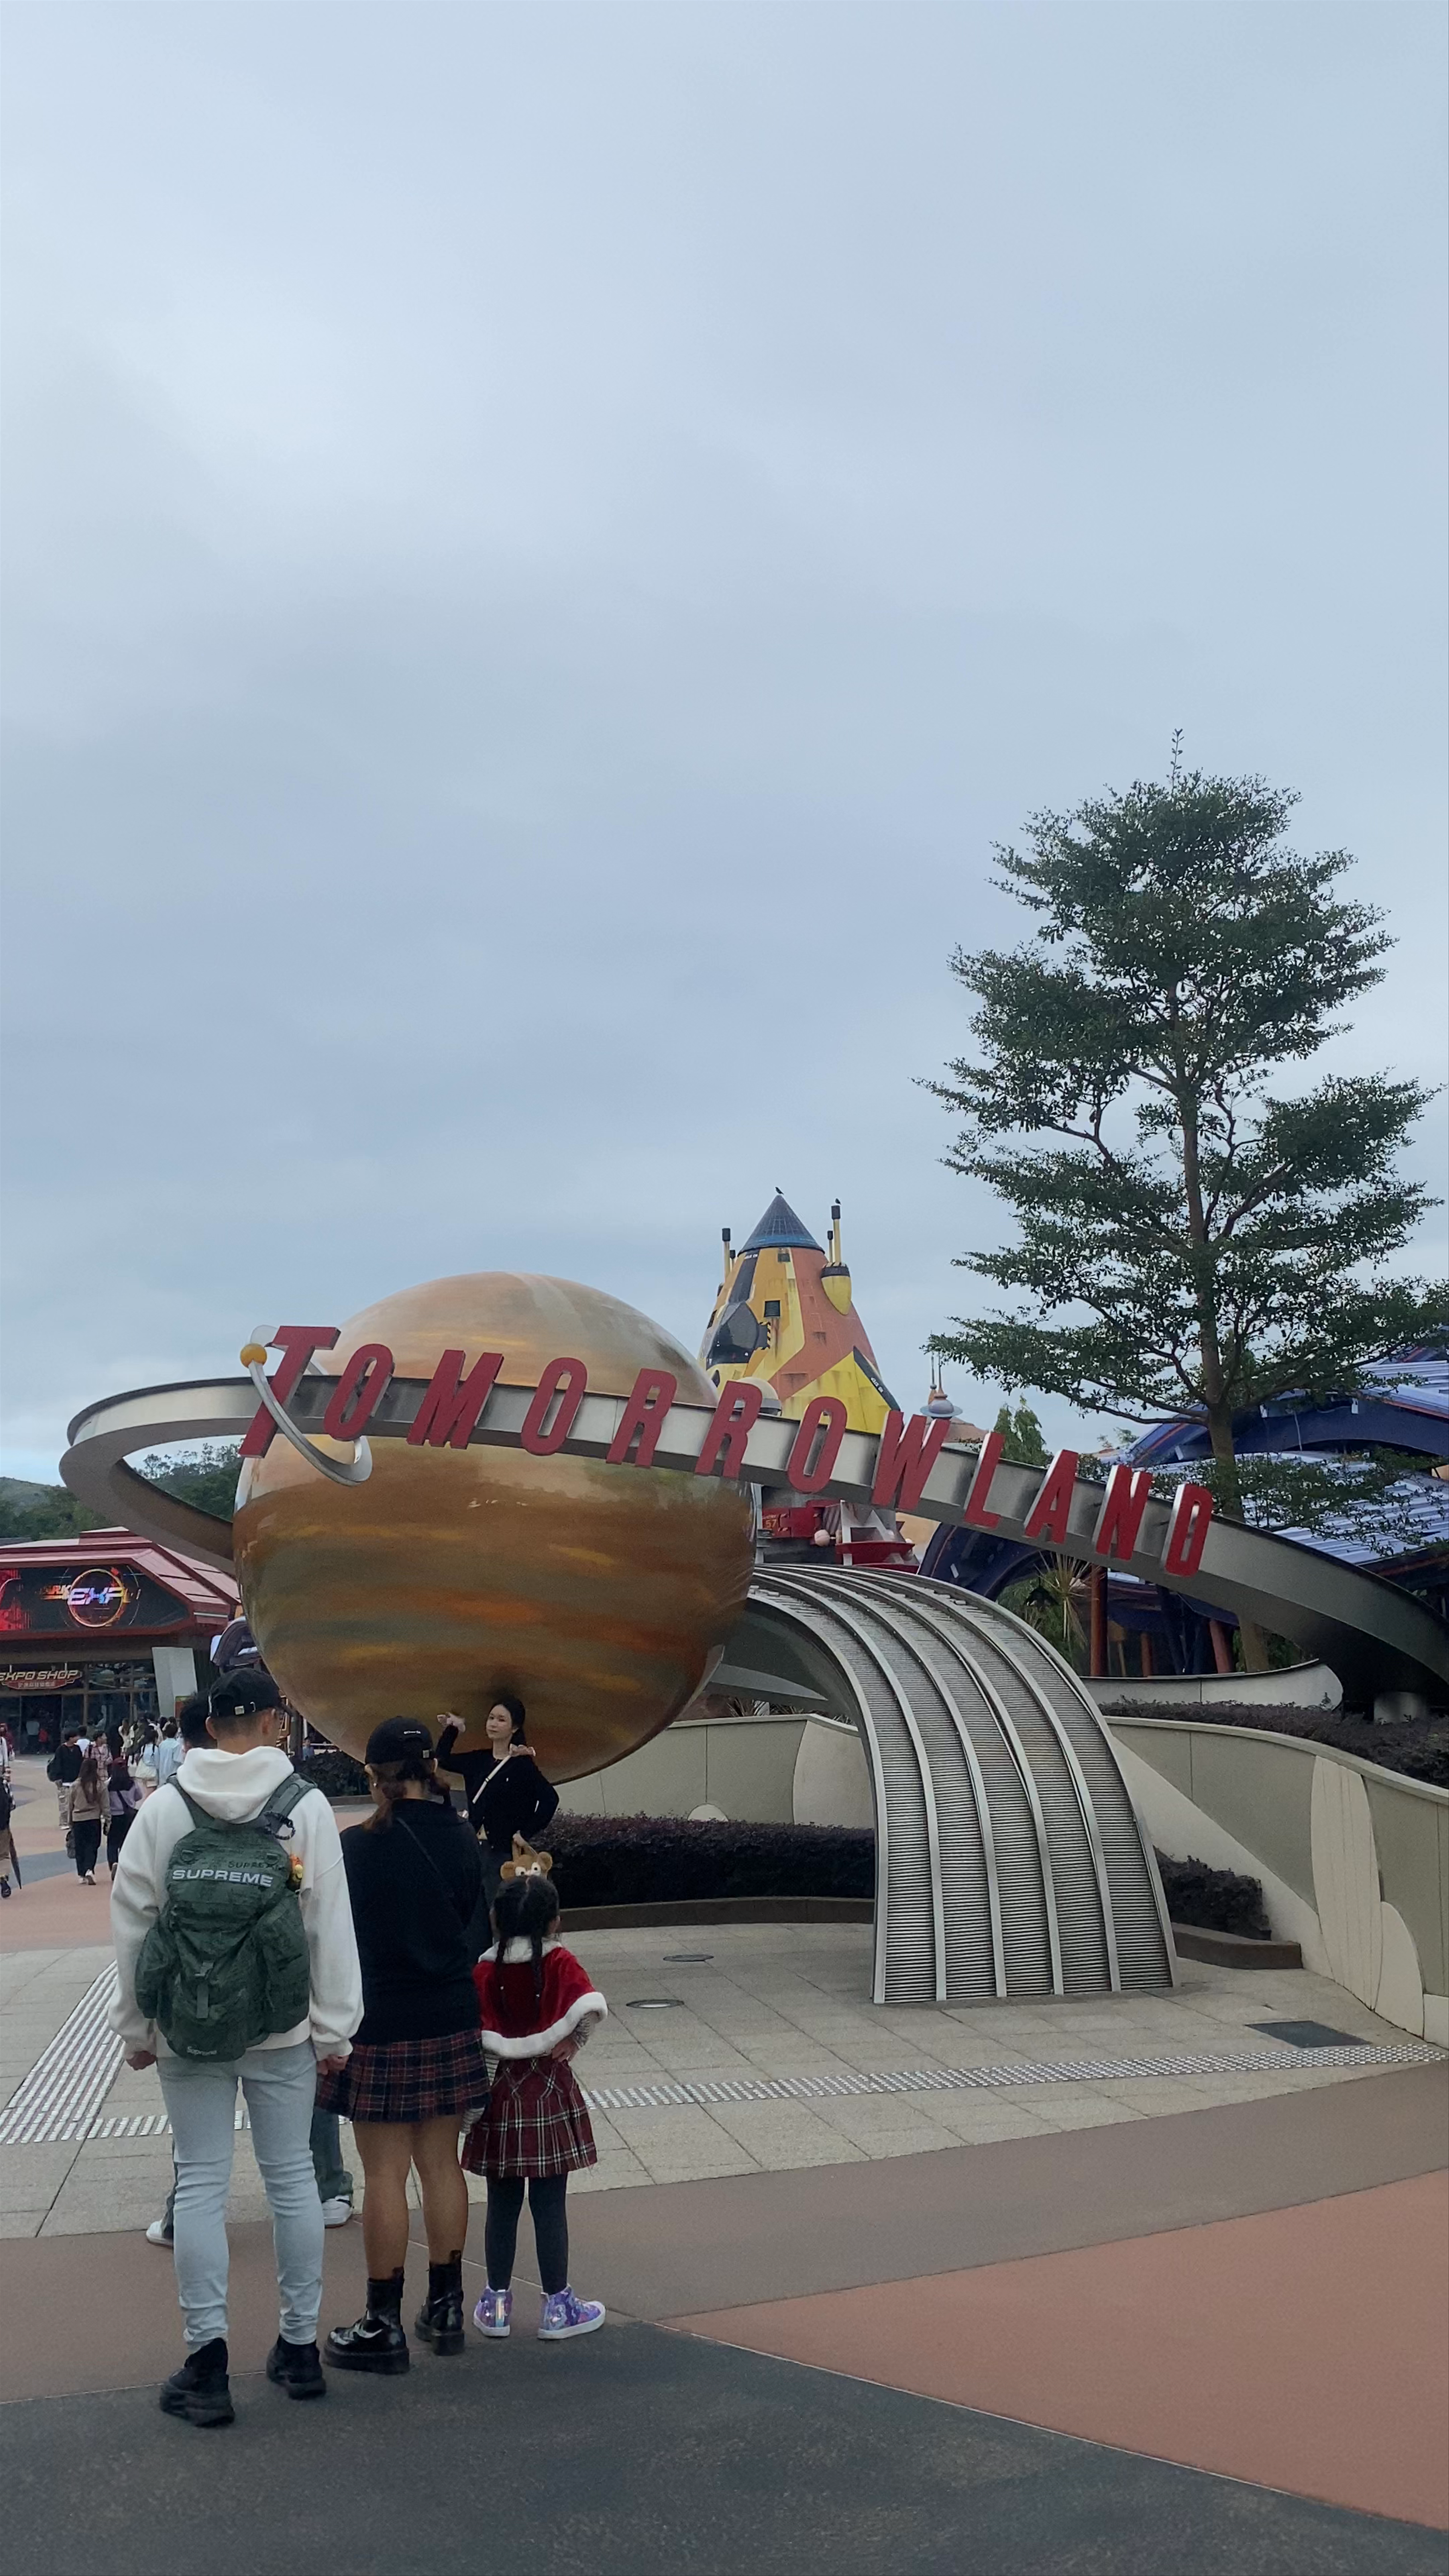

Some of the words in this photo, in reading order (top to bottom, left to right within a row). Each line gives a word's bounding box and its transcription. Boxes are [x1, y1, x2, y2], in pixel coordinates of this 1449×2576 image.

[239, 1326, 1213, 1576] TOMORROWLAND
[37, 1670, 78, 1679] SHOP
[172, 1870, 273, 1887] SUPREME
